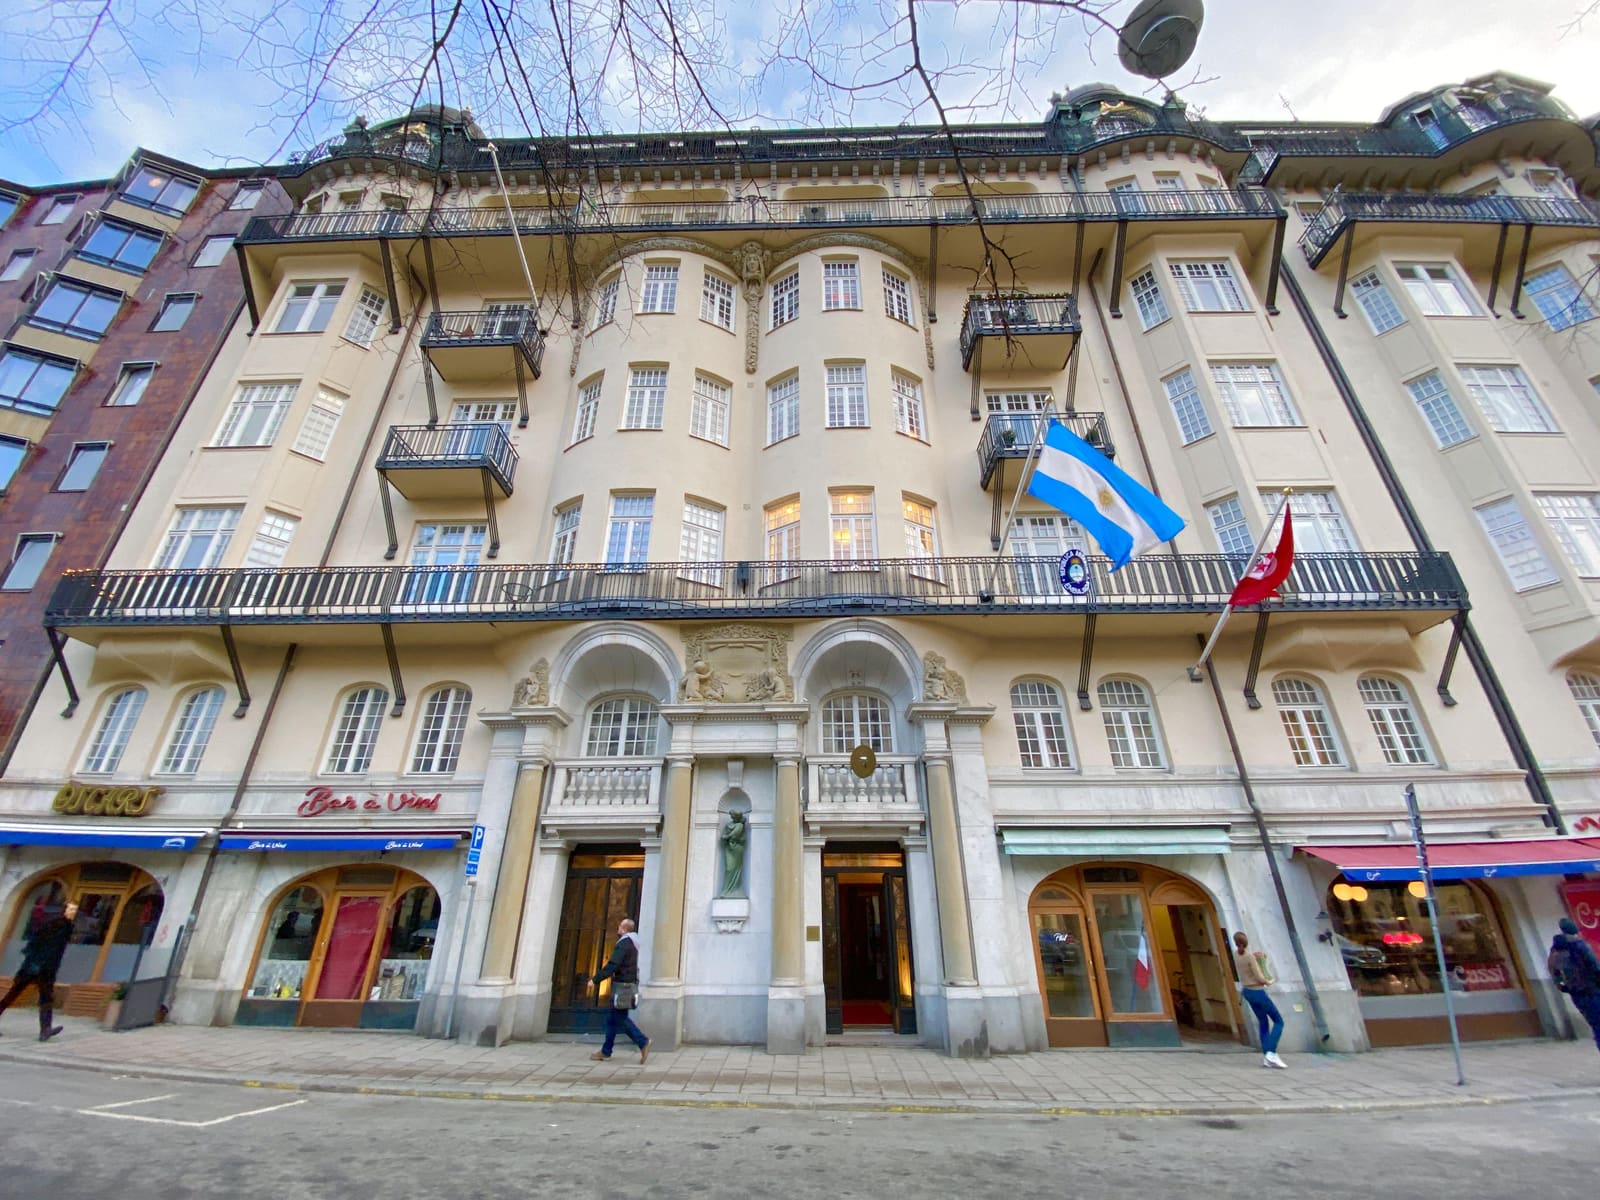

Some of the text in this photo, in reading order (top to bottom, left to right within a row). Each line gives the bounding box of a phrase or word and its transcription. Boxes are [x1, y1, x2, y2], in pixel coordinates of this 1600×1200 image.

[297, 786, 442, 817] Bar à Vins
[248, 841, 264, 849] Bar
[385, 841, 401, 849] Bar
[473, 827, 484, 847] P
[1454, 965, 1506, 983] Cassi
